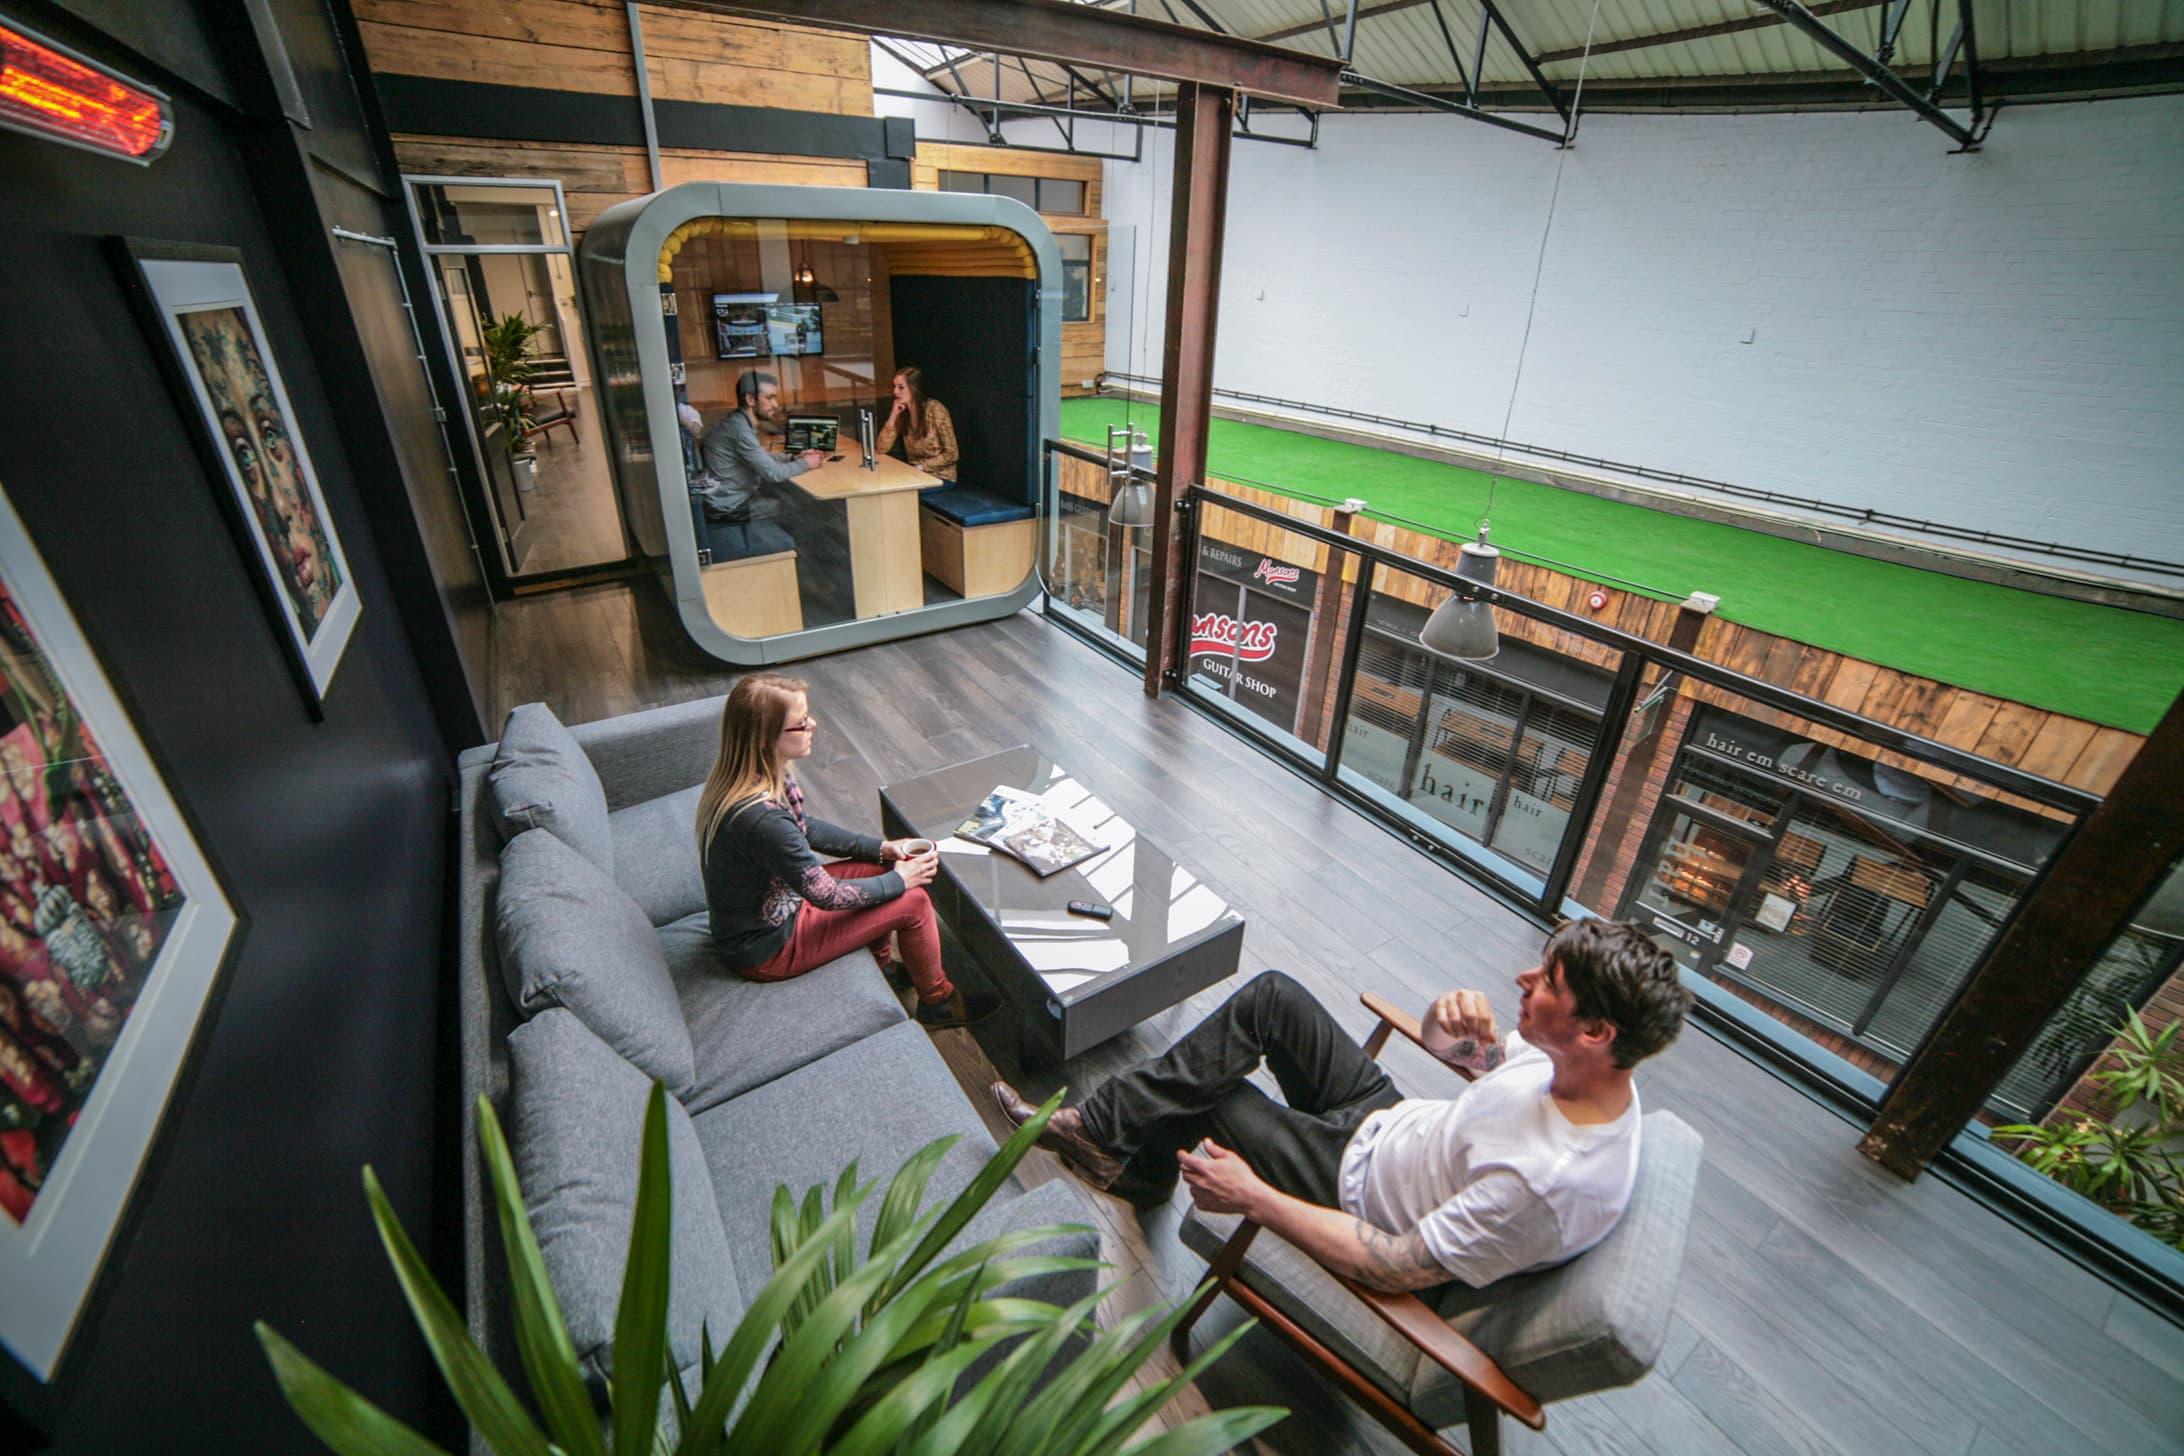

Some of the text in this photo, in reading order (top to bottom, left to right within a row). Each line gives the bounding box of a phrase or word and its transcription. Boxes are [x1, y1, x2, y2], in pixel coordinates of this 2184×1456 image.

[1210, 547, 1243, 568] REPAIRS
[1253, 558, 1300, 580] Mansons
[1192, 612, 1278, 650] ansons
[1245, 676, 1277, 698] SHOP
[1706, 732, 1743, 757] hair
[1778, 762, 1829, 788] scare
[1419, 763, 1485, 817] hair
[1512, 795, 1543, 818] hair
[1685, 932, 1700, 946] 12
